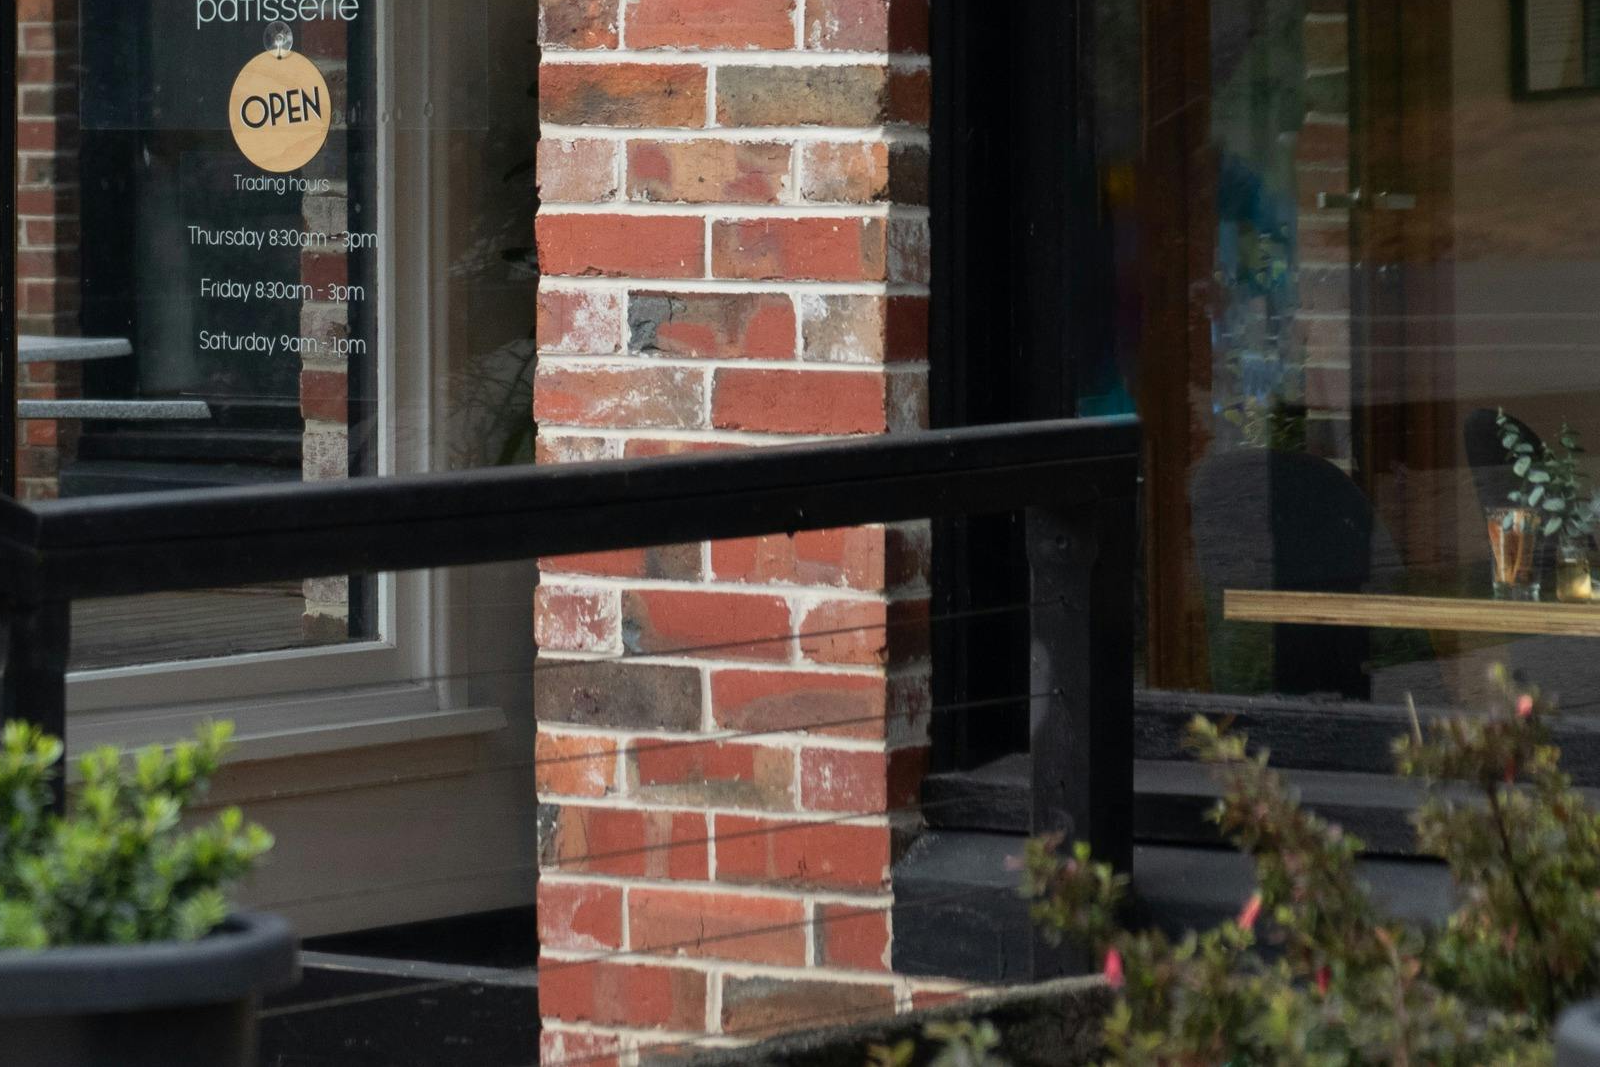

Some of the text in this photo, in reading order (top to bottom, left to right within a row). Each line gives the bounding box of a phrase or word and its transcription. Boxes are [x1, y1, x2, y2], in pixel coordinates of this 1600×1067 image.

[241, 86, 321, 129] OPEN
[234, 174, 330, 195] Trading hours
[188, 225, 265, 250] Thursday
[342, 231, 379, 252] 3pm
[201, 278, 251, 302] Friday
[327, 283, 365, 304] 3pm
[199, 330, 276, 356] Saturday
[280, 335, 318, 352] 9am
[333, 336, 366, 357] 1pm
